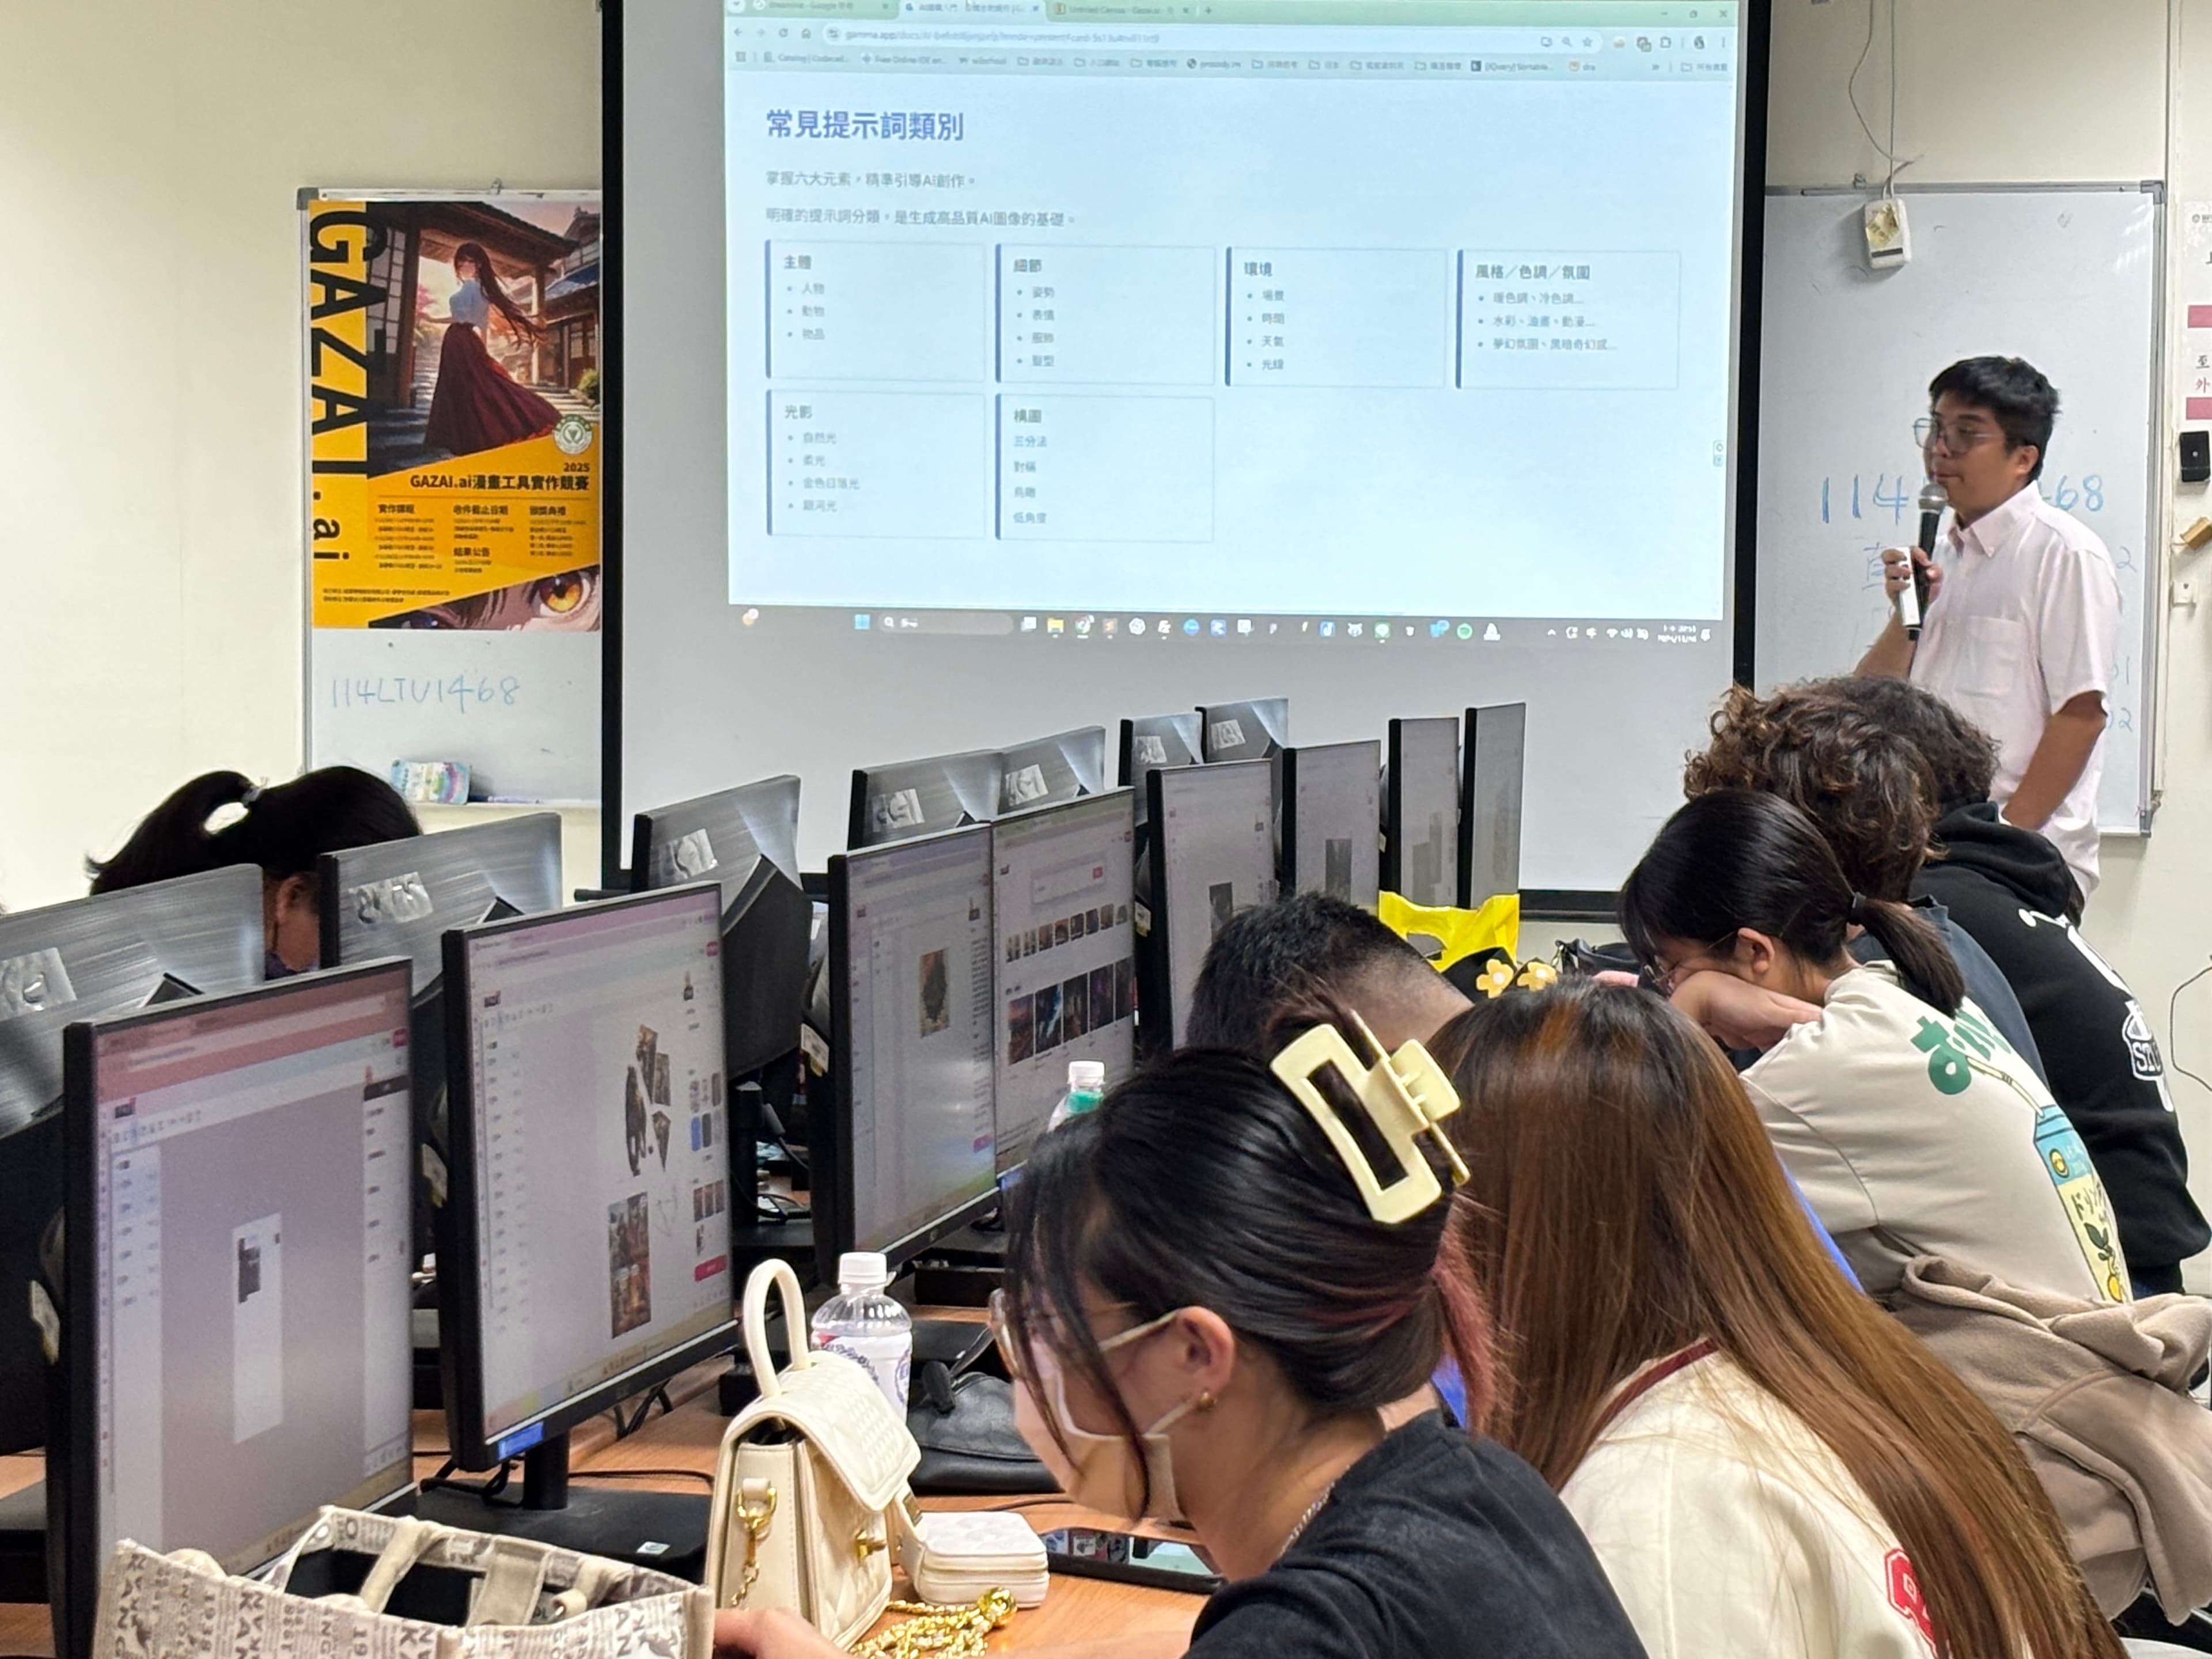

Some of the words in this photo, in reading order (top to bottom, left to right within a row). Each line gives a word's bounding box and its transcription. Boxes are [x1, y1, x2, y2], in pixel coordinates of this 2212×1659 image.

[766, 108, 964, 142] 常見提示詞類別
[783, 255, 812, 271] 主體
[1244, 262, 1272, 276] 環境
[801, 282, 825, 296] 人物
[1262, 312, 1285, 325] 時間
[1262, 335, 1285, 347] 天氣
[784, 404, 813, 421] 光影
[1013, 408, 1042, 424] 構圖
[802, 431, 837, 445] 自然光
[563, 463, 590, 473] 2025
